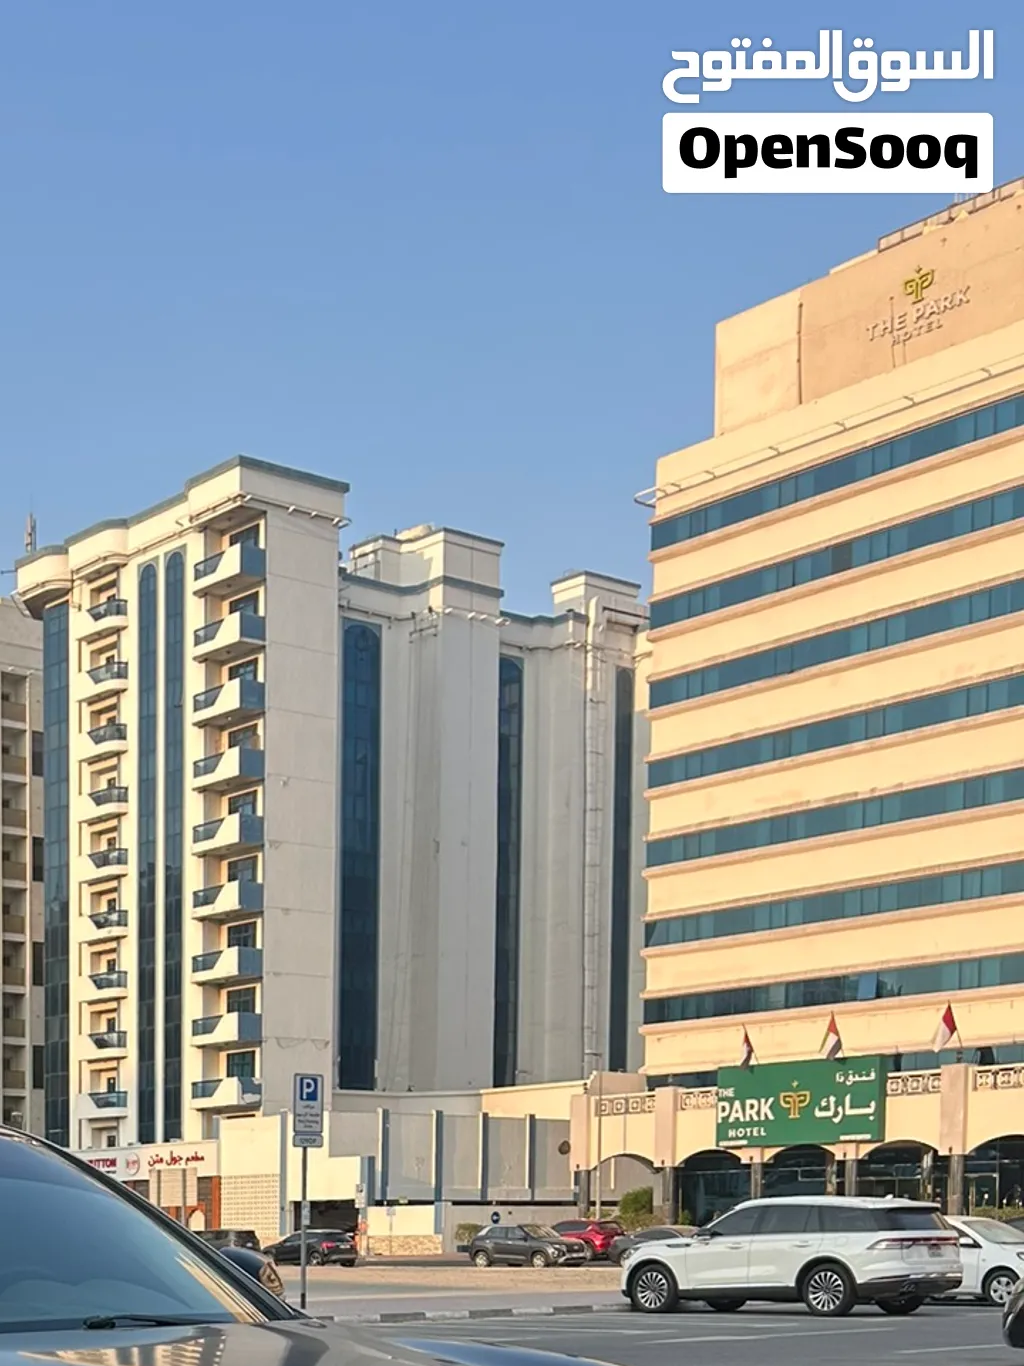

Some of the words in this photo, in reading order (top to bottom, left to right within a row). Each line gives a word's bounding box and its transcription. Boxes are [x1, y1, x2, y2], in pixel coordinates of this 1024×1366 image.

[866, 312, 908, 342] THE
[912, 285, 971, 324] PARK
[891, 318, 944, 347] HOTEL
[846, 1068, 876, 1086] فندق
[302, 1079, 315, 1100] P
[718, 1087, 735, 1098] THE
[717, 1096, 775, 1124] PARK
[814, 1093, 876, 1124] بارك
[728, 1127, 767, 1138] HOTEL
